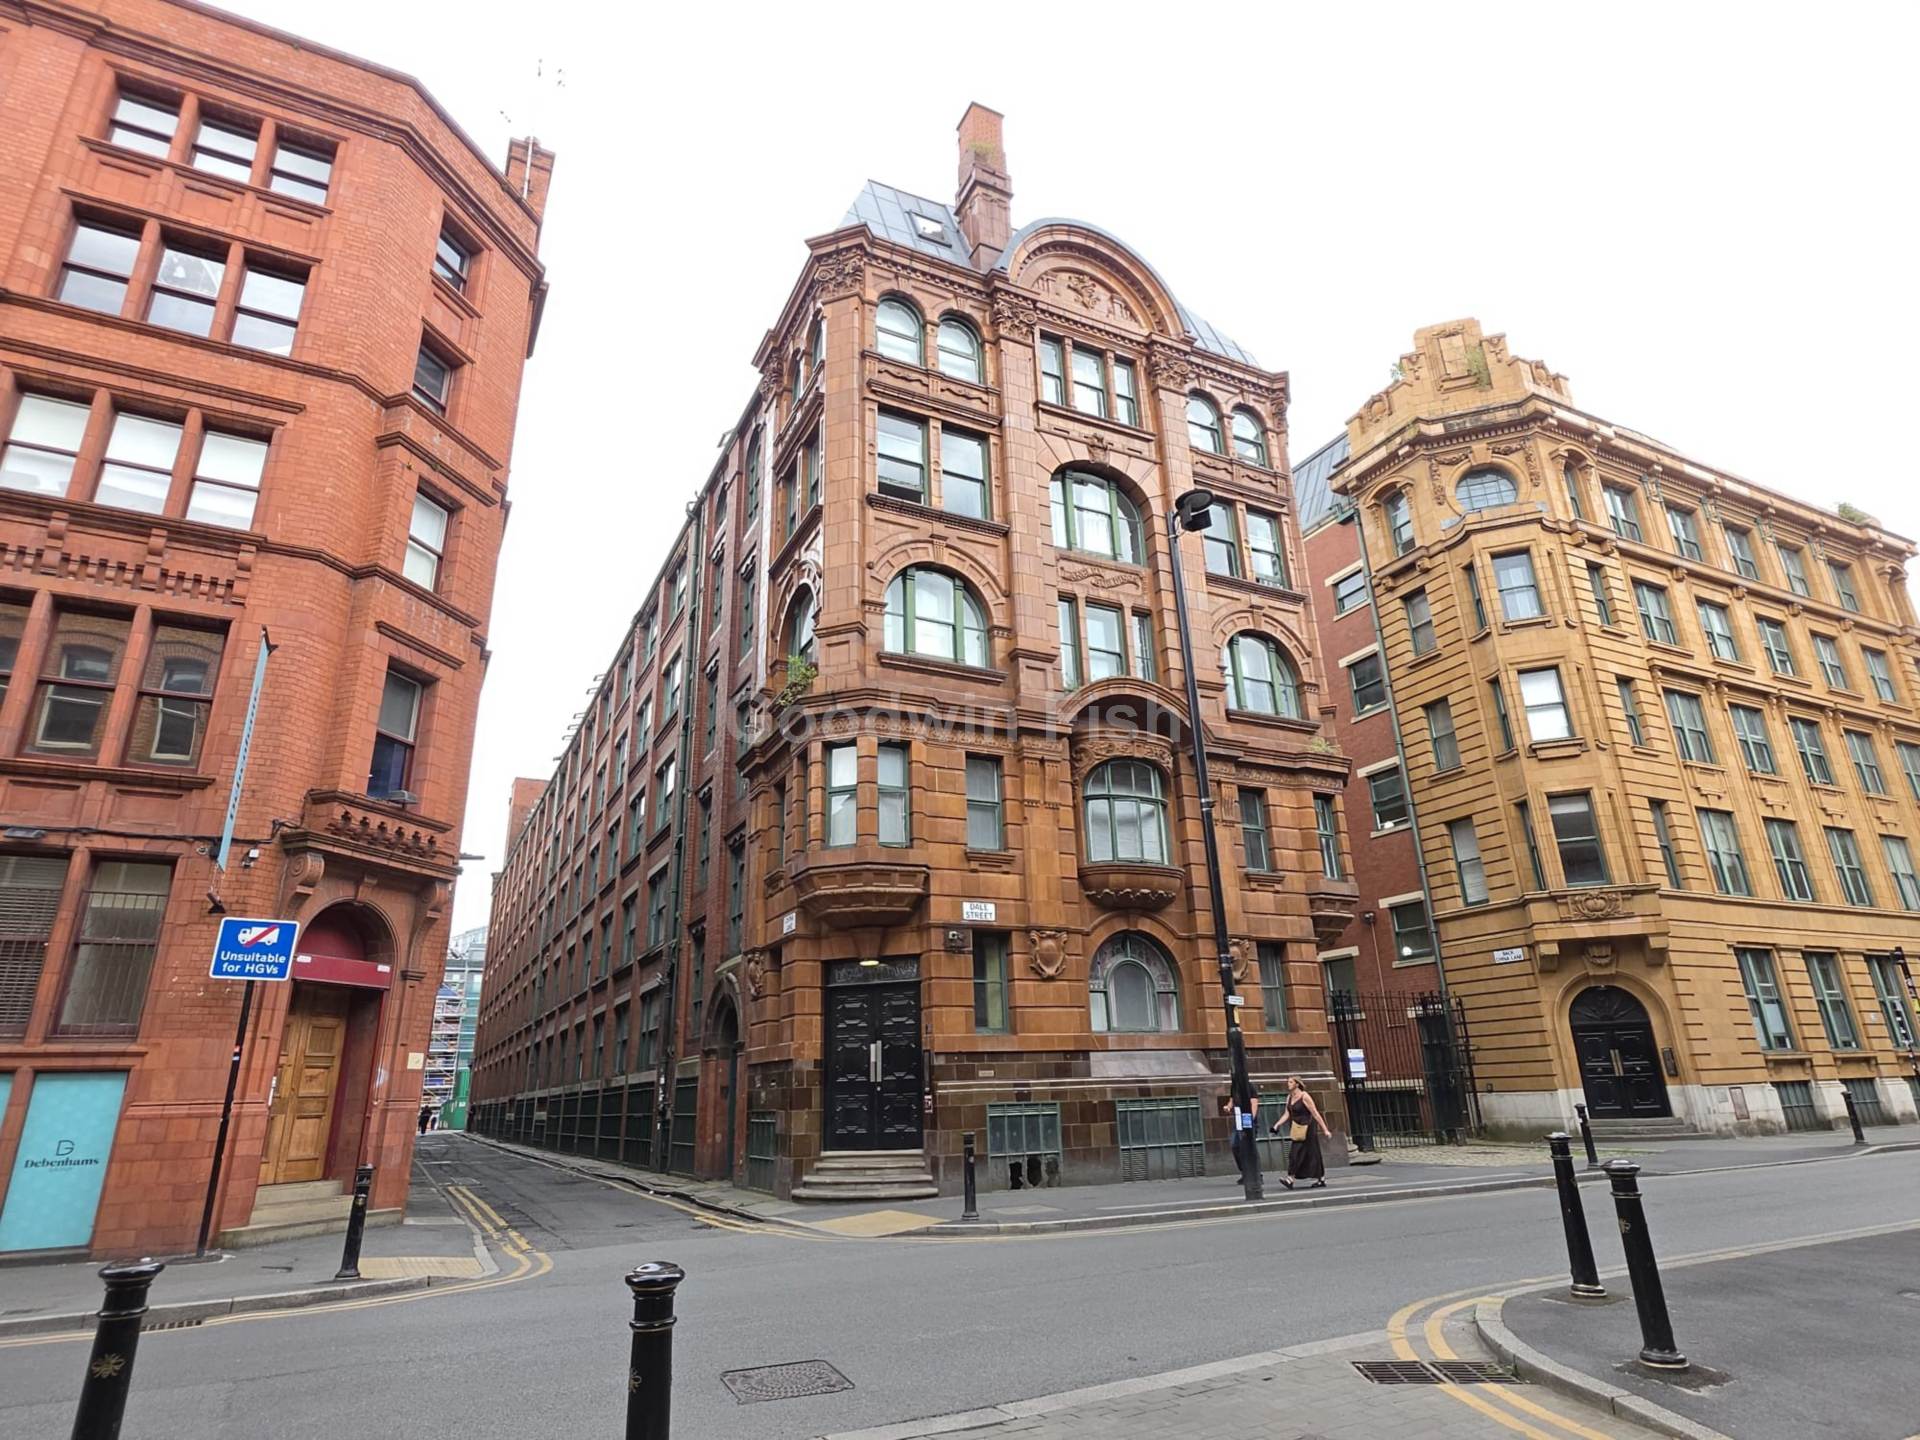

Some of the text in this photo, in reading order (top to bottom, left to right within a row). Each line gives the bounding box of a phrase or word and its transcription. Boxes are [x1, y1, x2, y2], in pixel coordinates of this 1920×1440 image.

[970, 903, 988, 911] DALE
[966, 911, 992, 919] STREET
[220, 951, 286, 963] Unsuitable
[222, 962, 279, 974] for HGVs
[24, 1157, 99, 1168] Debenhams
